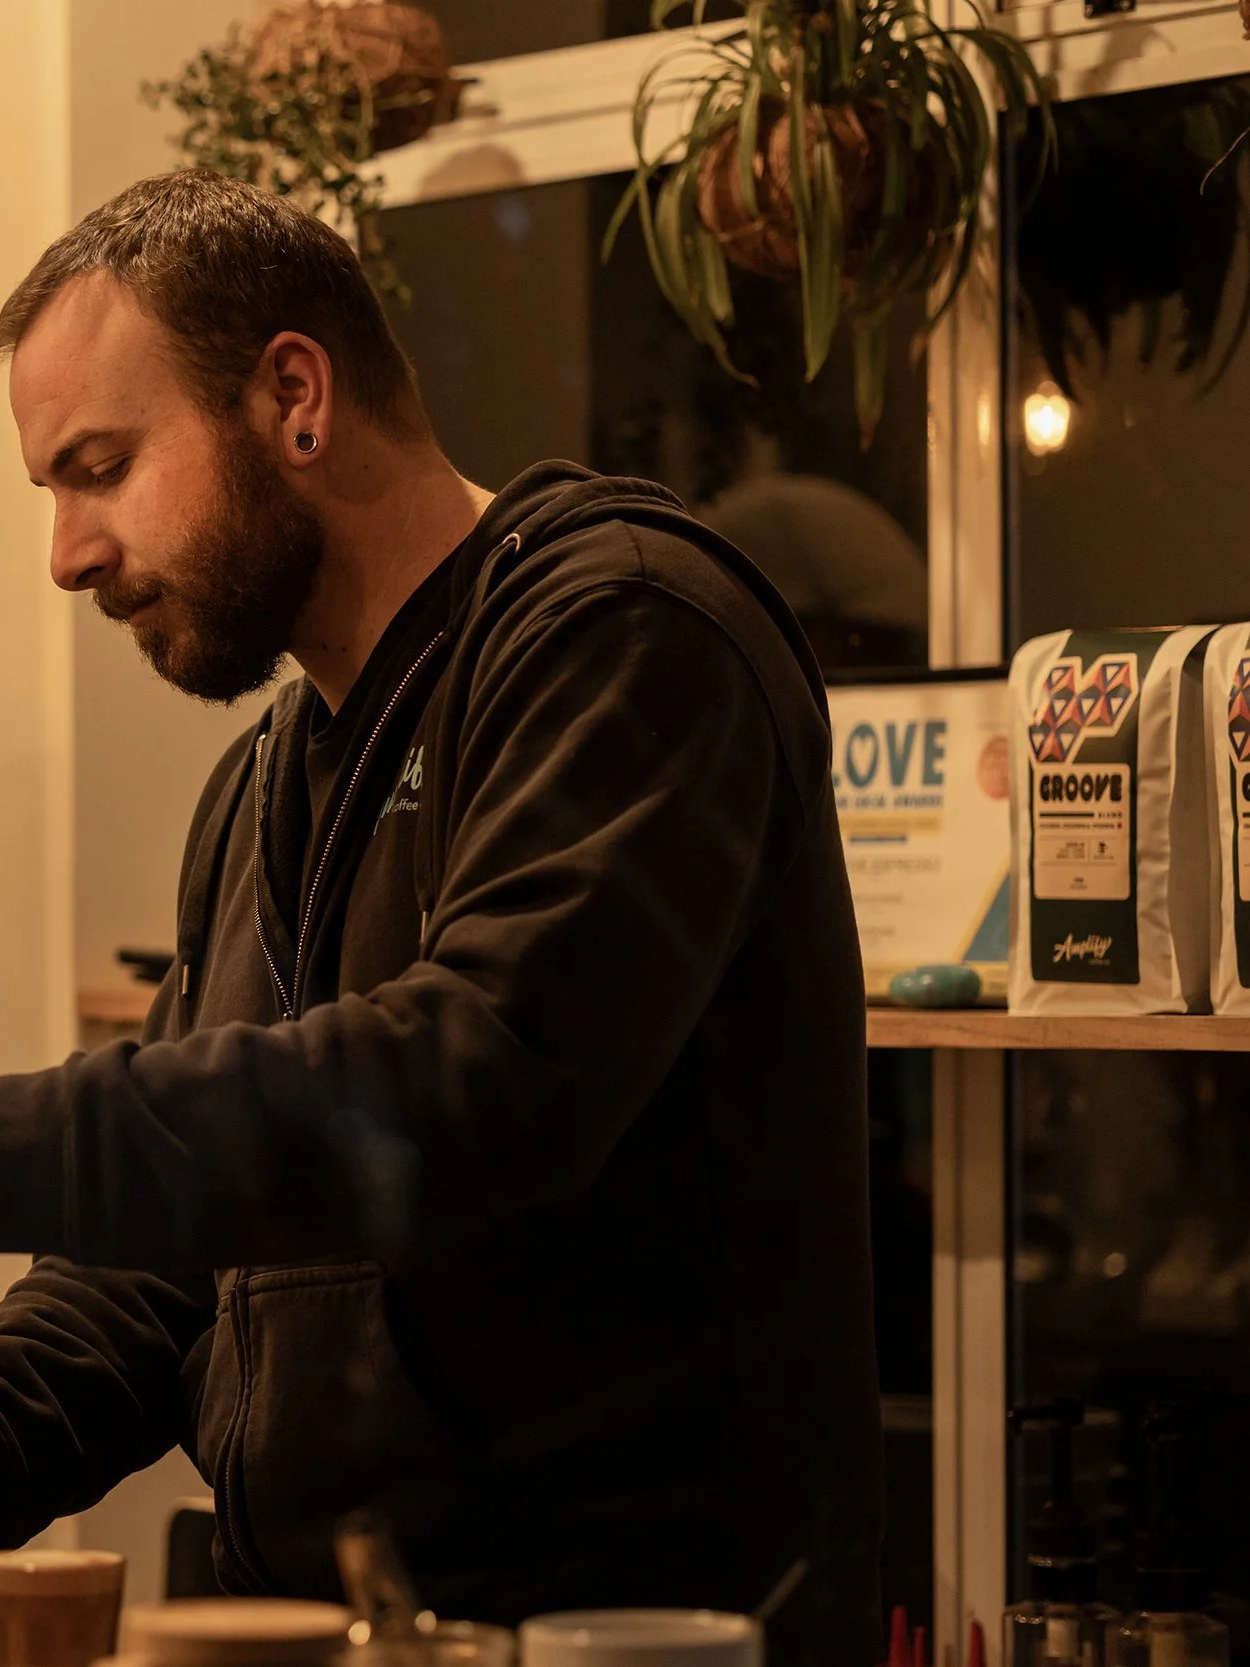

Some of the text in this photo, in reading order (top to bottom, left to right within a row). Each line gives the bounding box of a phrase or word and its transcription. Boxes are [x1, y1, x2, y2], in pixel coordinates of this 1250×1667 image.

[831, 720, 947, 789] OVE
[1040, 774, 1122, 802] GROOVE
[1053, 933, 1113, 963] Amplify
